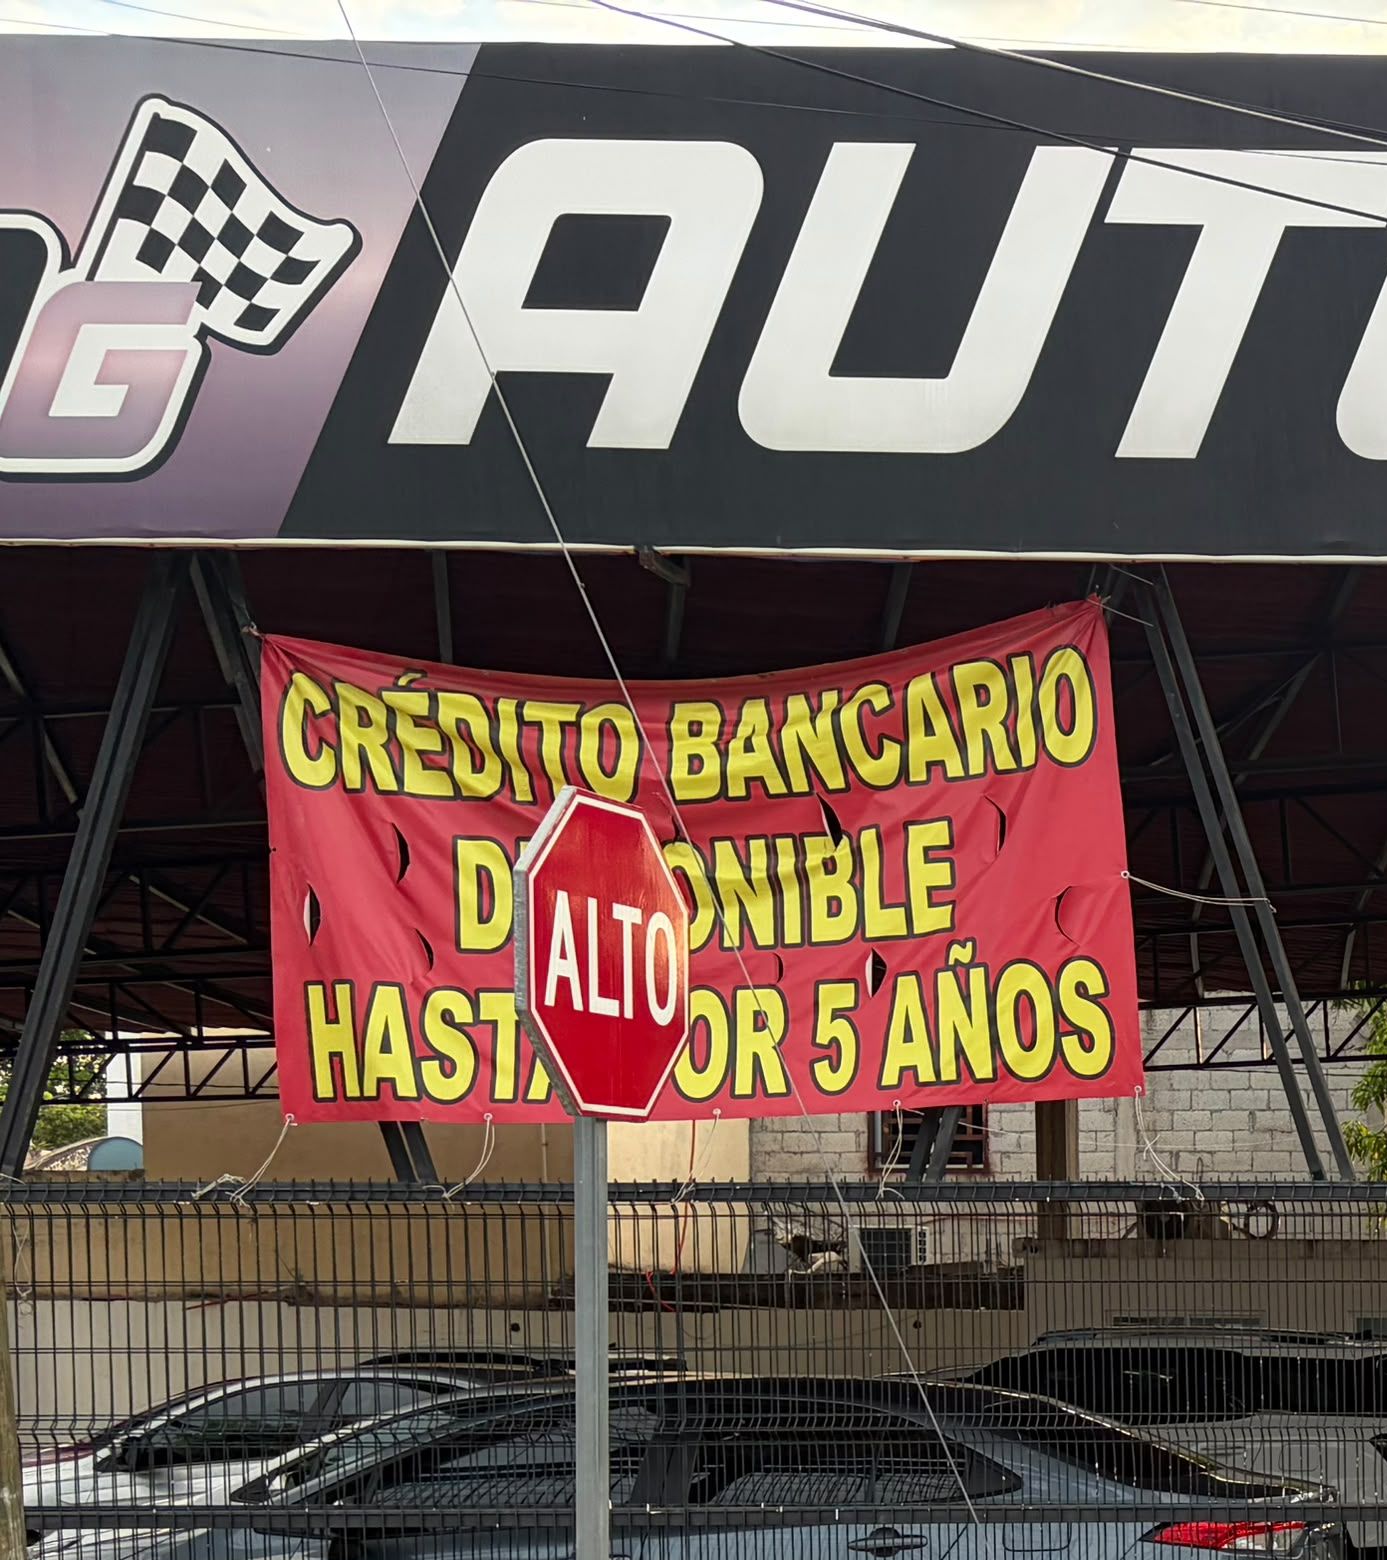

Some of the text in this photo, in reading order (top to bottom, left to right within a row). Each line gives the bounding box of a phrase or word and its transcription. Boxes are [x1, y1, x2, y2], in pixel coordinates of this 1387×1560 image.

[279, 644, 1097, 803] CRÉDITO BANCARIO
[453, 816, 956, 954] DONIBLE
[544, 889, 678, 1027] ALTO
[304, 937, 1117, 1102] HAST OR 5 AÑOS
